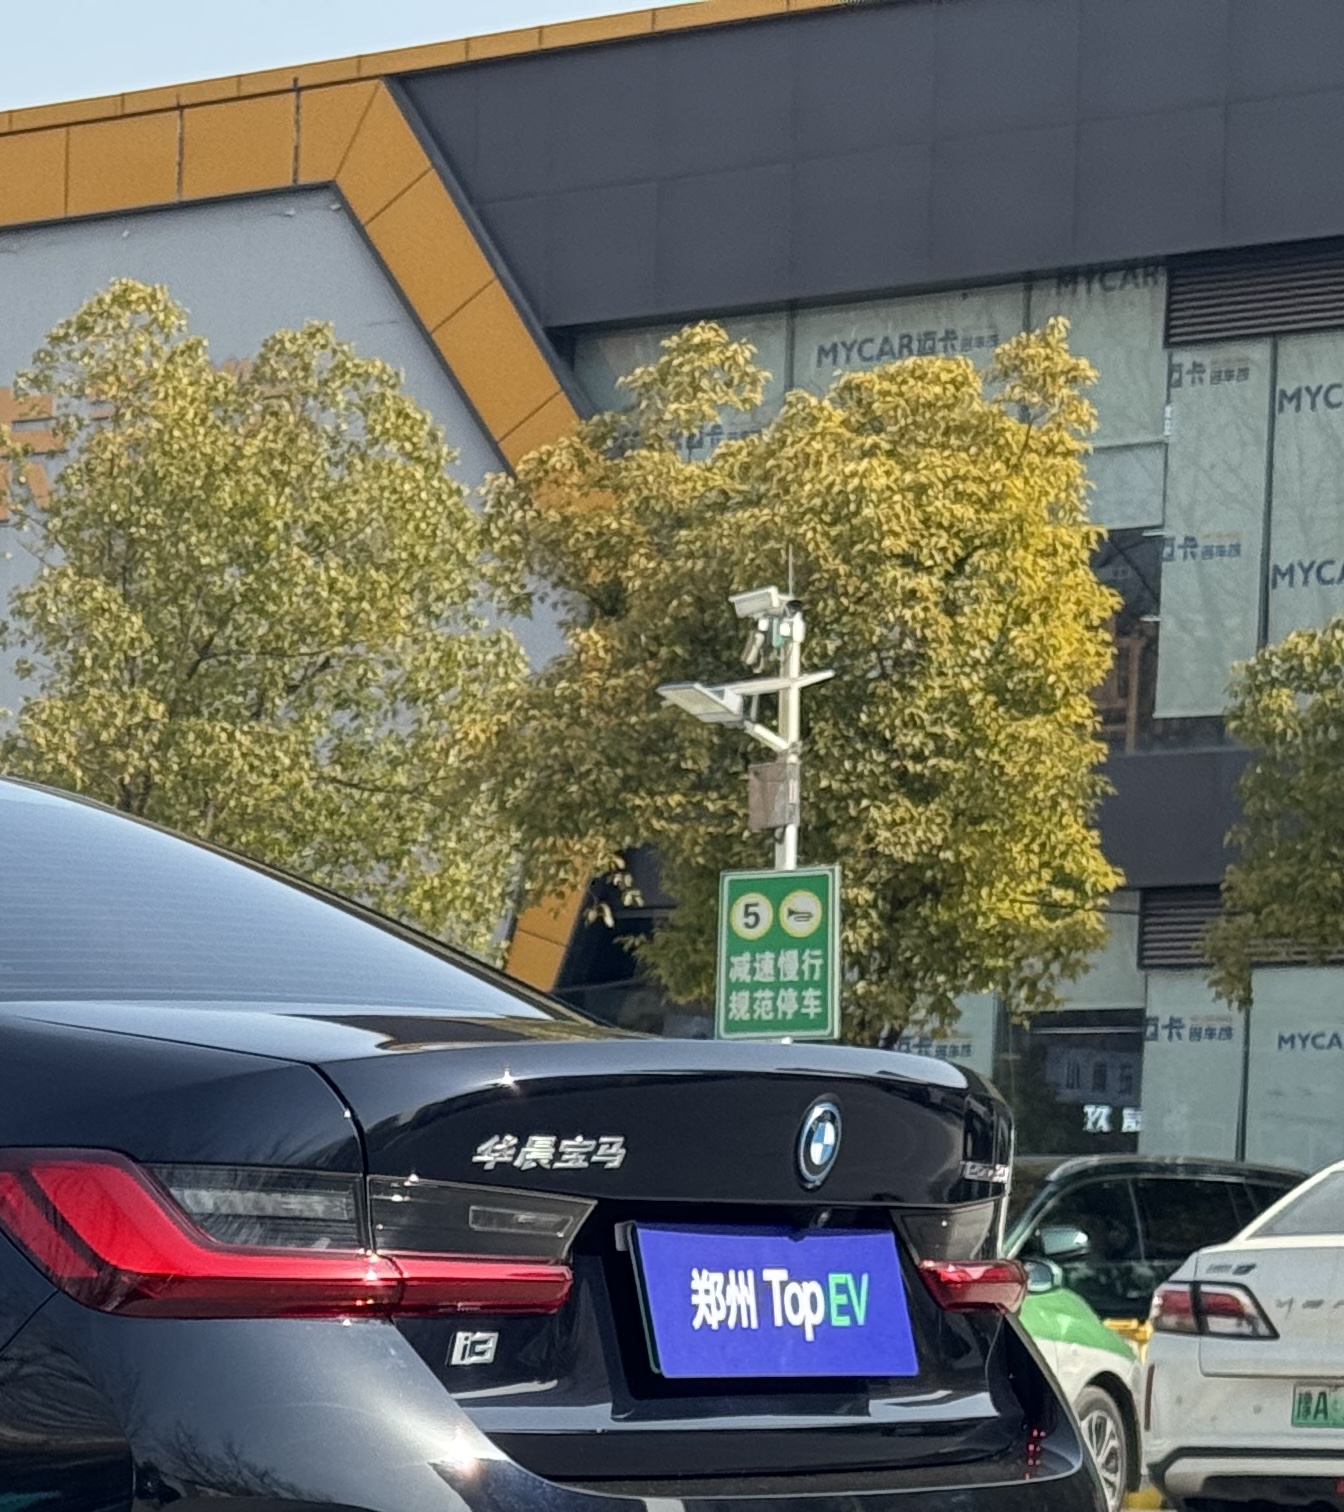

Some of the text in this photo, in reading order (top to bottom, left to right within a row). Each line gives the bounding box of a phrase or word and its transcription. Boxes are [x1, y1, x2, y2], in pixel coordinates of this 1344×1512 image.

[816, 333, 913, 369] MYCAR
[743, 902, 760, 930] 5
[729, 948, 825, 984] 减速慢行
[728, 987, 824, 1021] 规范停车
[471, 1133, 627, 1171] 华晨宝马
[690, 1267, 759, 1331] 郑州
